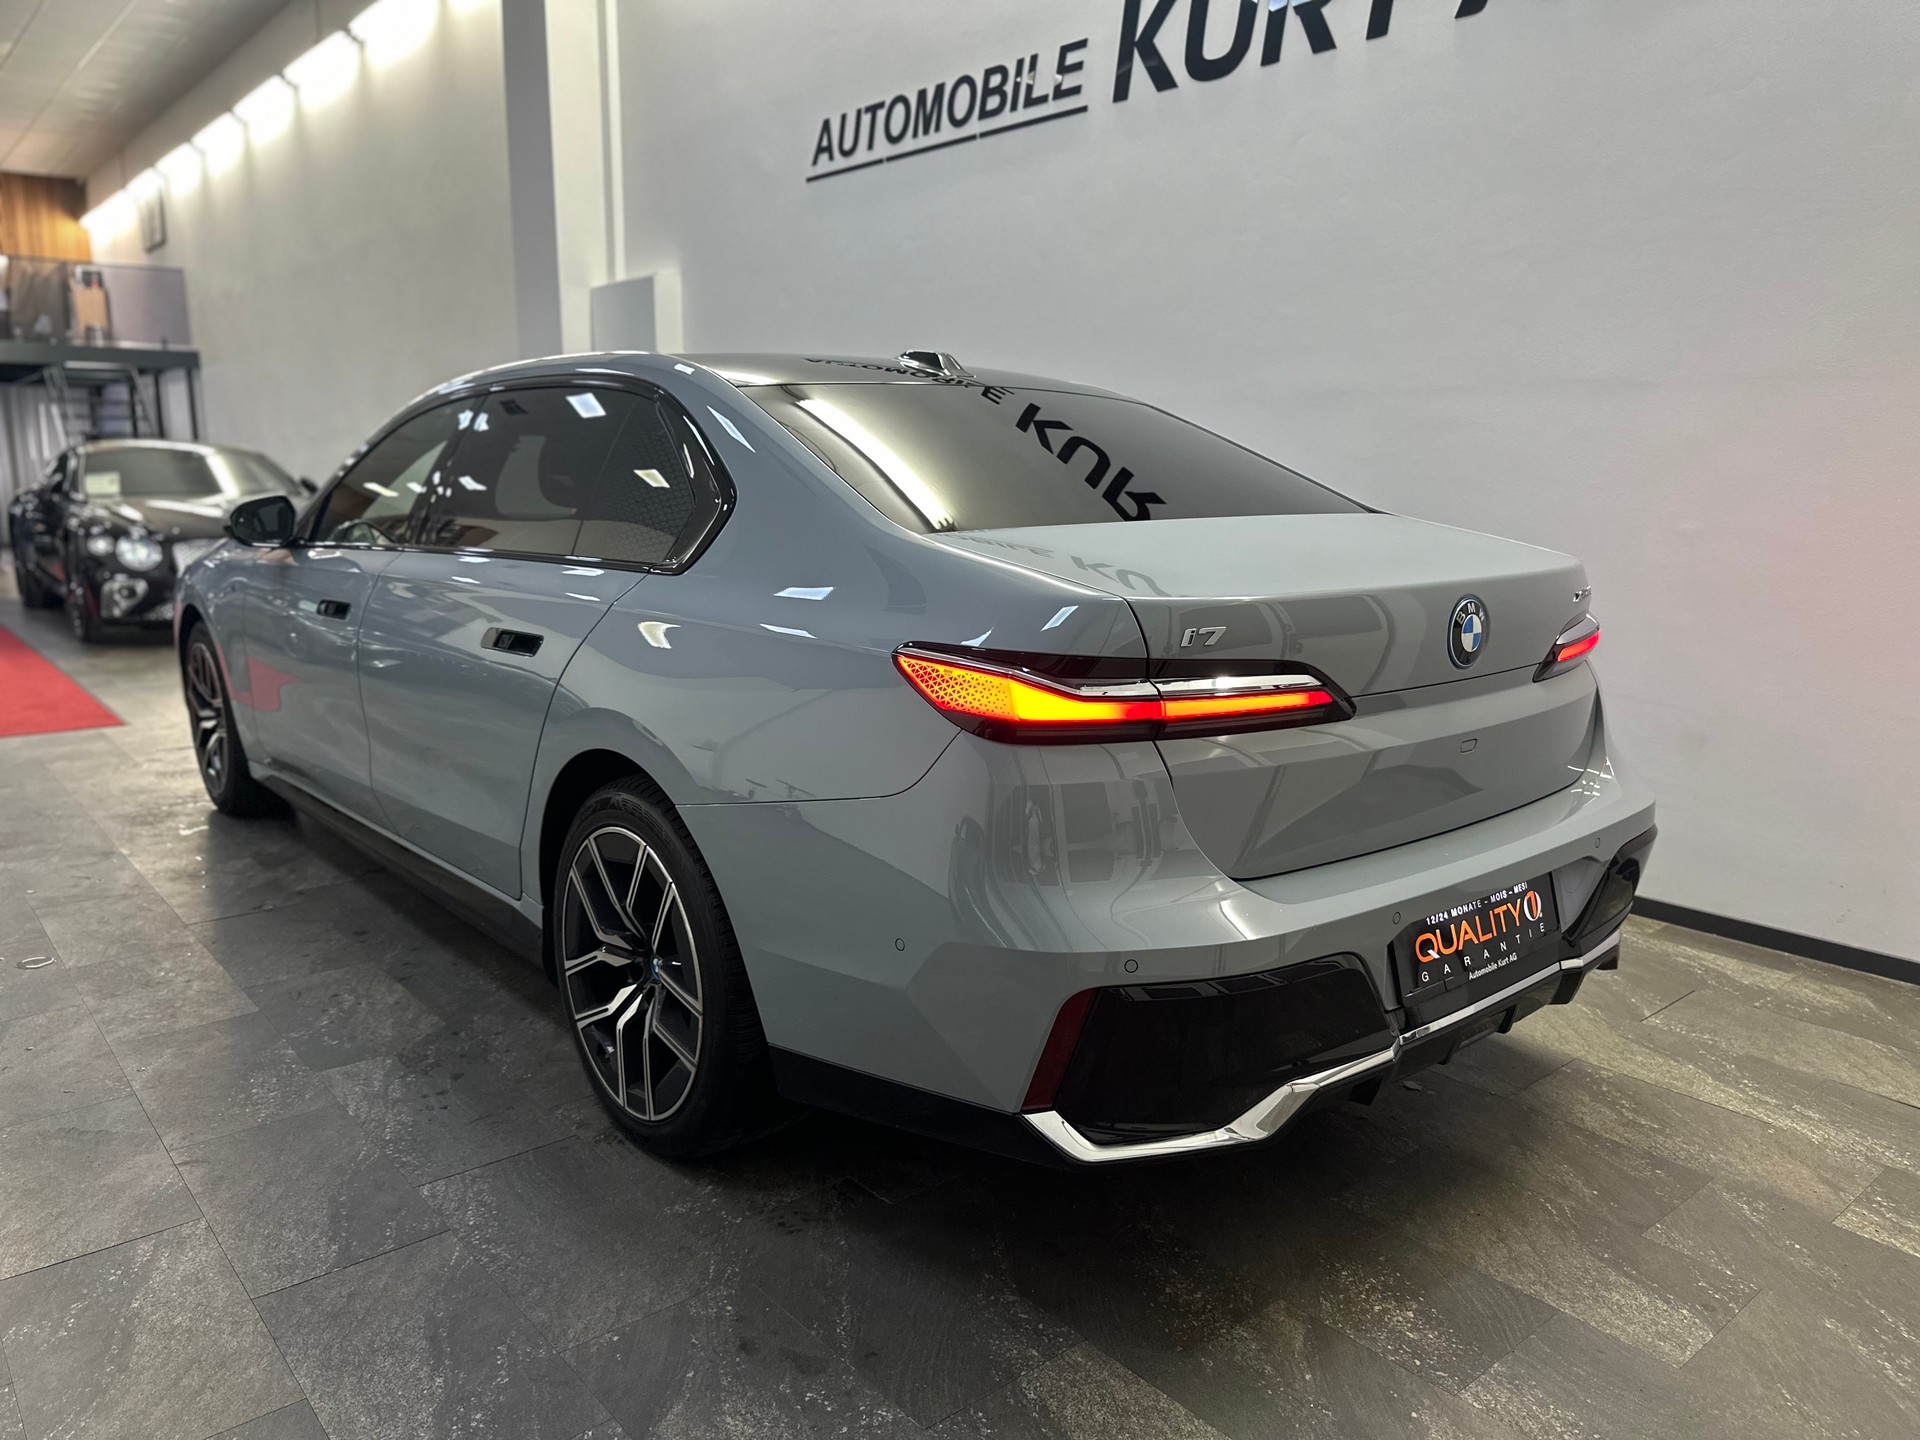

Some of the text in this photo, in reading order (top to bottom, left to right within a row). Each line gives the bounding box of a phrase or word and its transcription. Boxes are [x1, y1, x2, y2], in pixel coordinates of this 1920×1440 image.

[811, 37, 1089, 167] AUTOMOBILE
[1180, 626, 1227, 647] i7
[1426, 912, 1449, 926] 12/24
[1450, 899, 1482, 918] MONATE
[1490, 889, 1507, 903] MOIS
[1513, 881, 1528, 894] MESI
[1421, 922, 1545, 982] GARANTIE
[1468, 952, 1518, 981] Automobile Kurt AG
